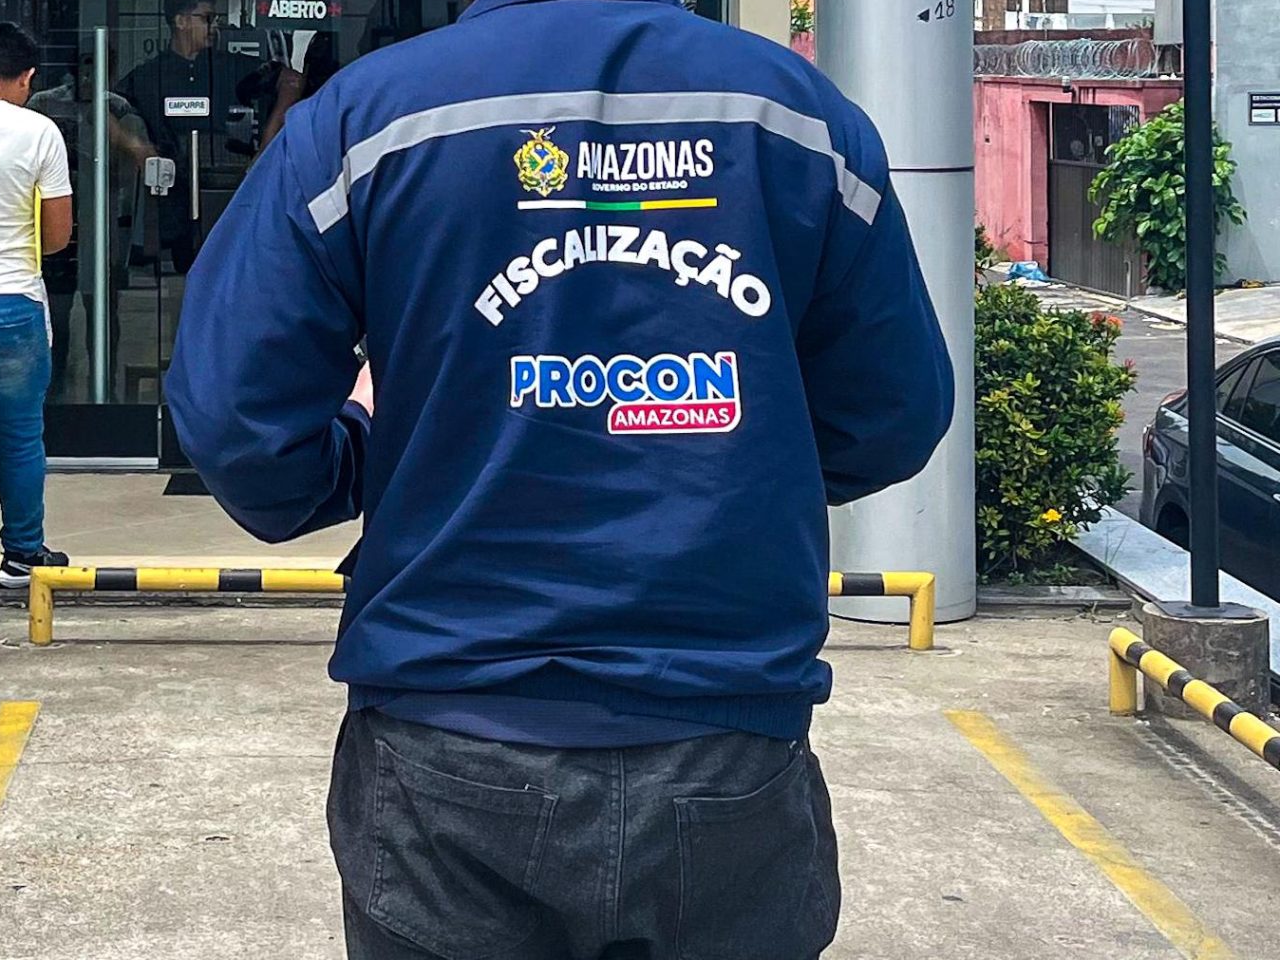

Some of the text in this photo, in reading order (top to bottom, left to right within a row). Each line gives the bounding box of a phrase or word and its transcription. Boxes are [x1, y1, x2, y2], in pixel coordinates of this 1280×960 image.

[268, 0, 328, 19] ABERTO
[168, 101, 205, 110] EMPURRE
[577, 139, 714, 181] AMAZONAS
[632, 182, 648, 192] DO
[649, 180, 689, 191] ESTADO
[474, 225, 772, 327] FISCALIZAÇÃO
[512, 353, 737, 406] PROCON
[615, 408, 730, 426] AMAZONAS
